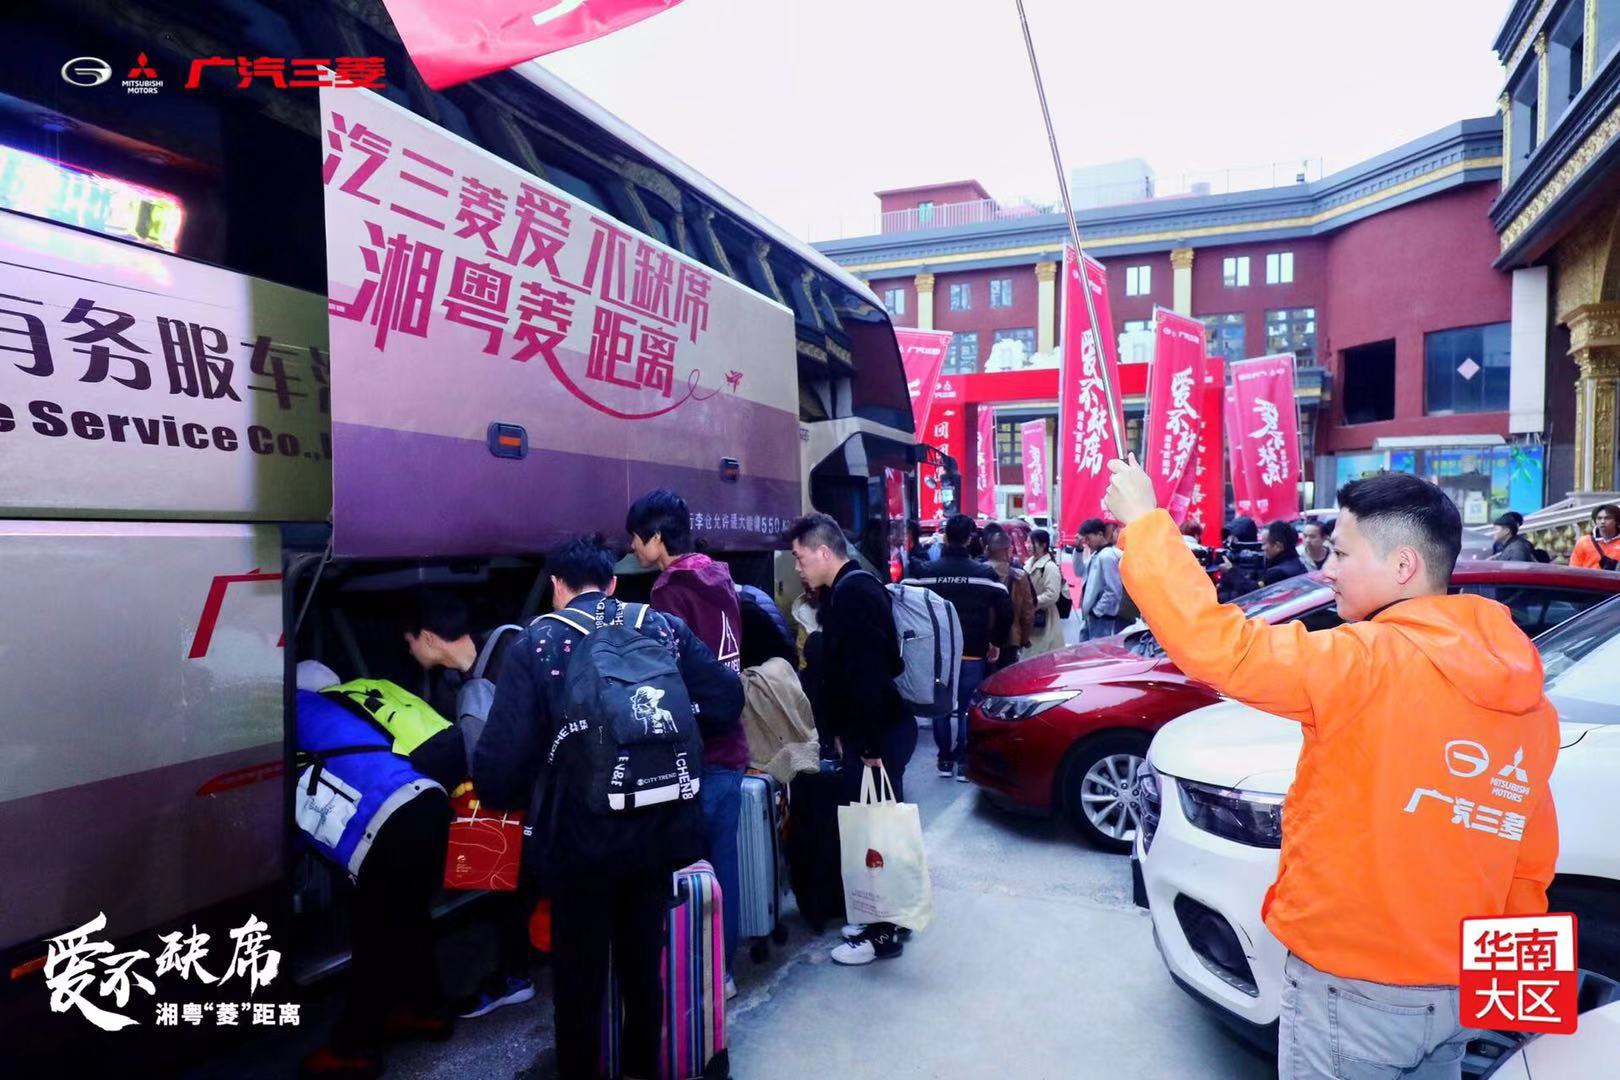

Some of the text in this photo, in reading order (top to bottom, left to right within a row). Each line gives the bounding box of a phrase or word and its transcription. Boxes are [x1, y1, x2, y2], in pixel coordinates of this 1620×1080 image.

[28, 400, 239, 451] Service
[937, 576, 968, 584] FATHER
[1490, 777, 1531, 795] MITSUBISHI
[1491, 788, 1524, 803] MOTORS
[1403, 787, 1526, 841] 广汽三菱
